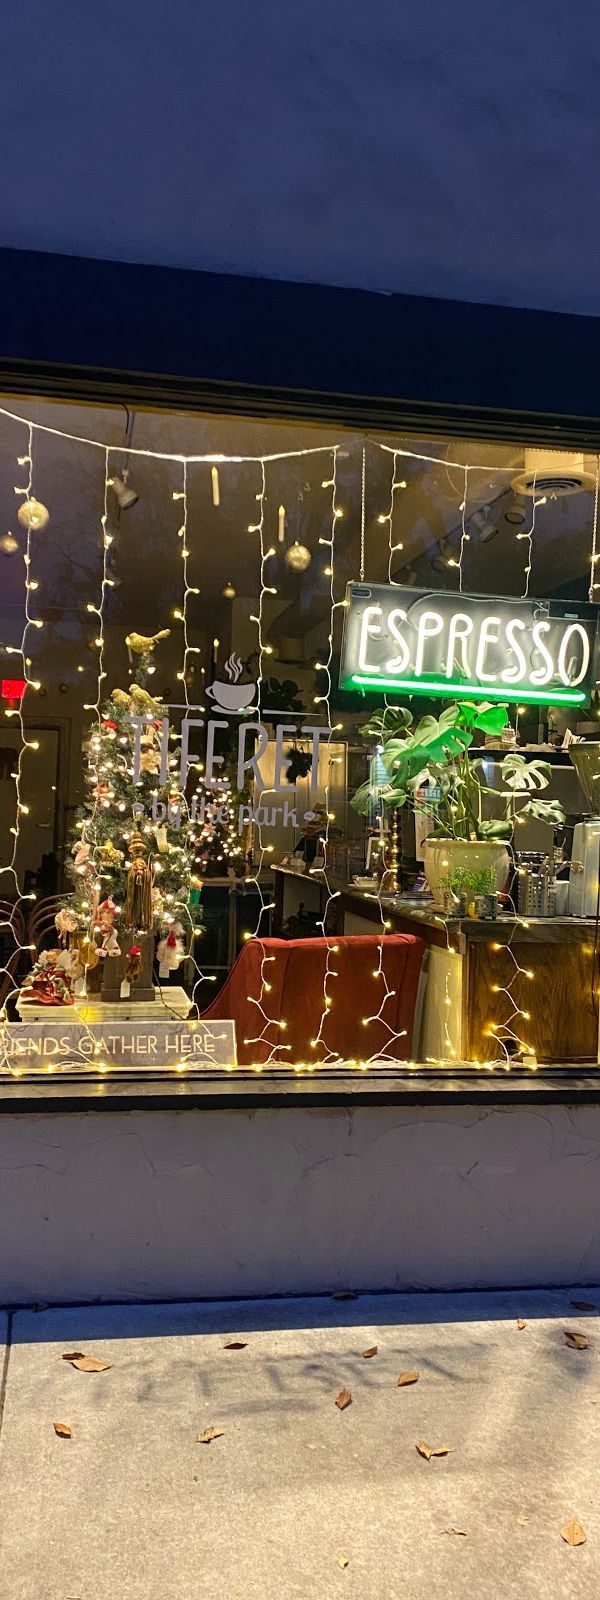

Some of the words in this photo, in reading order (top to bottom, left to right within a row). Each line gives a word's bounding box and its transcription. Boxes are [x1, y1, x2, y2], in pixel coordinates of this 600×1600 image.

[358, 606, 590, 687] ESPRESSO
[123, 715, 333, 793] TIFERET
[151, 796, 182, 832] by
[191, 797, 230, 825] the
[238, 801, 300, 834] park
[78, 1035, 157, 1055] GATHER
[165, 1034, 216, 1054] HERE
